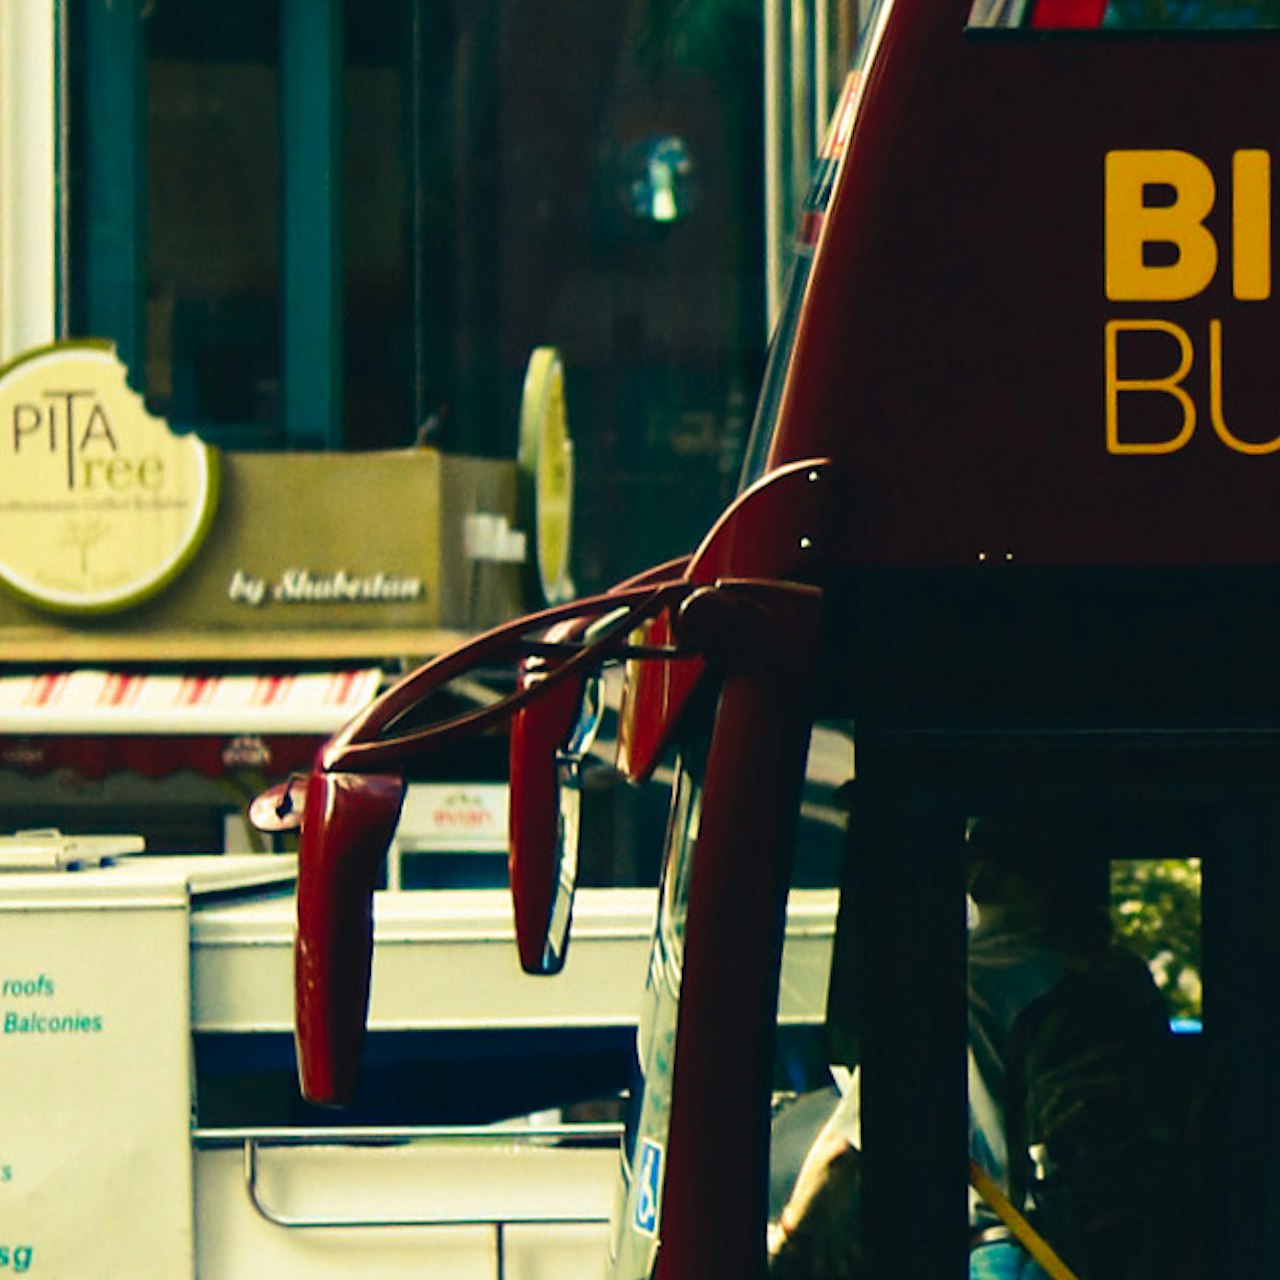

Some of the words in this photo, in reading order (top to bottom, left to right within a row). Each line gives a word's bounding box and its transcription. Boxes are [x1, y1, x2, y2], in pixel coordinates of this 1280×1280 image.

[14, 390, 117, 489] PITA
[229, 571, 265, 604] by
[275, 569, 422, 600] Shabestan
[2, 974, 54, 997] roofs
[3, 1012, 103, 1034] Balconies
